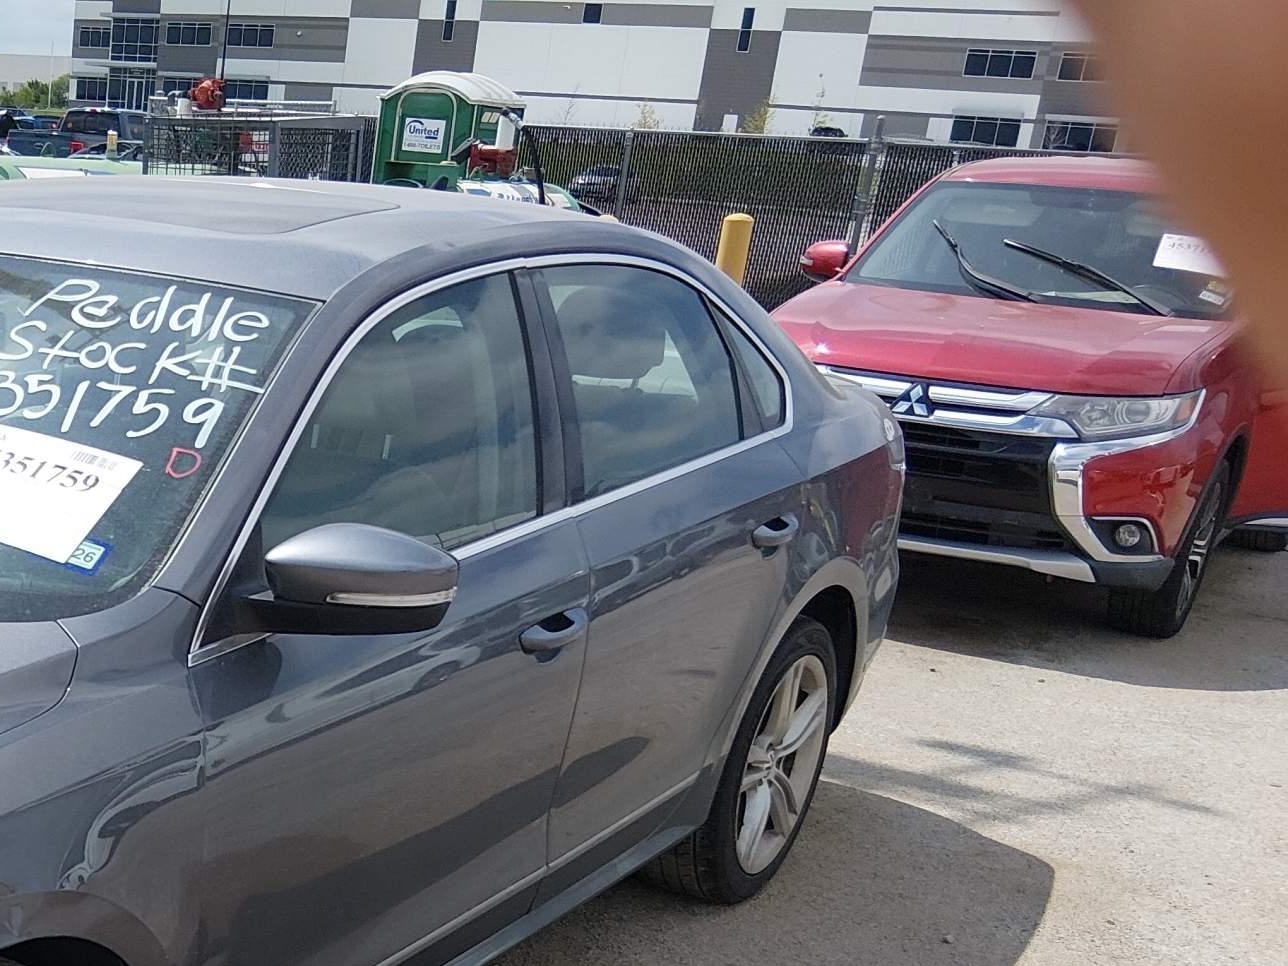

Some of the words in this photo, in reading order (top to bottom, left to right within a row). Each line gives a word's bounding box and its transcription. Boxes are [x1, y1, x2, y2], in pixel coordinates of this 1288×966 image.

[408, 124, 440, 137] United
[17, 277, 270, 343] Peddle
[71, 547, 97, 564] 26
